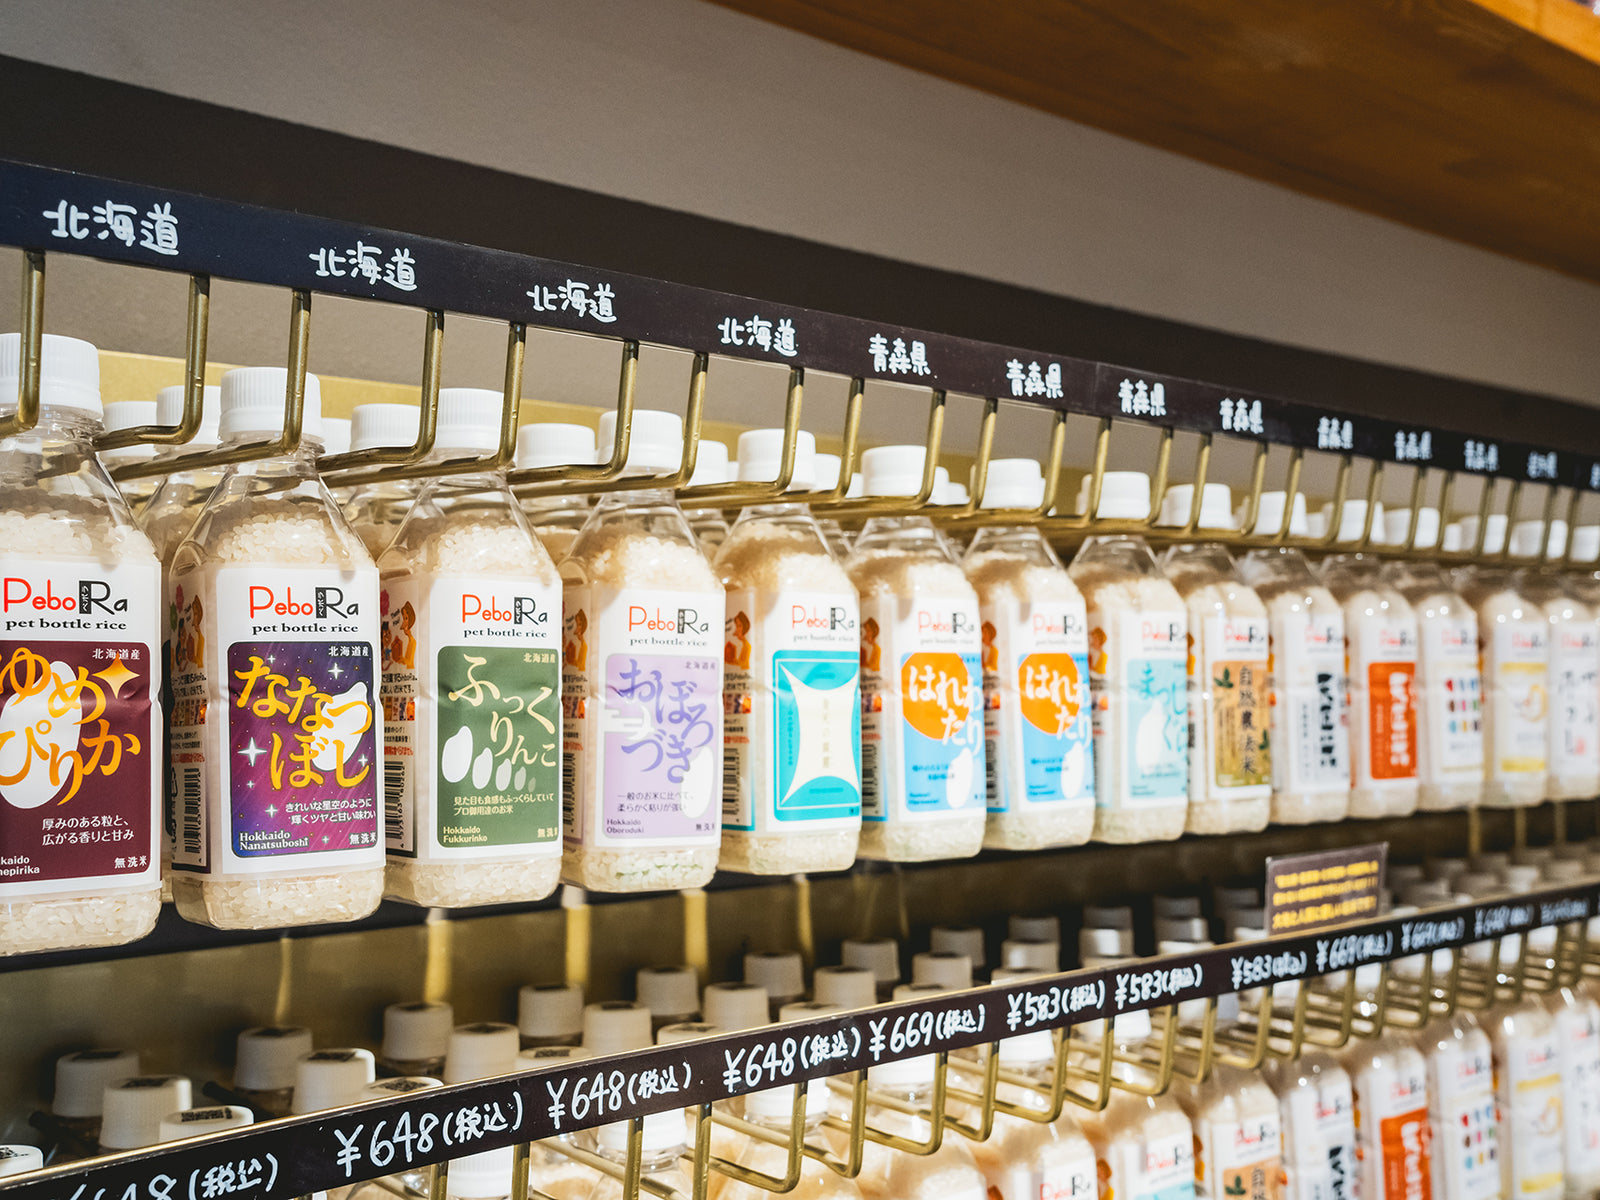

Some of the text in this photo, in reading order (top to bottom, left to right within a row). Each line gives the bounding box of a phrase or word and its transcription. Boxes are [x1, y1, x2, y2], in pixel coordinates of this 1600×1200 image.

[43, 200, 180, 255] 北海道
[309, 241, 417, 291] 北海道
[526, 279, 617, 322] 北海道
[717, 315, 798, 357] 北海道
[868, 332, 932, 376] 青森県
[1005, 358, 1065, 399] 青森県
[1118, 379, 1166, 416] 青森県
[6, 618, 127, 631] pet bottle rice
[253, 622, 359, 635] pet bottle rice
[464, 627, 547, 639] pet bottle rice
[630, 637, 707, 647] pet bottle rice
[92, 648, 140, 660] 北海道産
[328, 645, 369, 657] 北海道産
[0, 647, 107, 725] ゆめ
[234, 656, 373, 735] ななつ
[448, 653, 556, 735] ふっく
[619, 658, 714, 749] おぼろ
[909, 664, 984, 713] はれわ
[1025, 664, 1092, 709] はれわ
[490, 711, 557, 767] りんこ
[941, 707, 983, 758] たり
[1056, 704, 1092, 749] たり
[0, 718, 141, 806] ぴりか
[271, 732, 370, 790] ぼし
[621, 729, 692, 784] づき
[285, 798, 372, 813] きれいな星空のように
[290, 810, 377, 825] 輝くツヤと甘い味わい
[454, 793, 554, 806] 見た目も食感もふっくらしていて
[454, 805, 514, 816] プロ御用達のお米
[42, 815, 129, 831] 厚みのある粒と、
[42, 829, 135, 846] 広がる香りと甘み
[240, 830, 291, 841] Hokkaido
[240, 838, 309, 850] Nanatsuboshi
[349, 831, 377, 845] 無洗米
[443, 826, 480, 835] Hokkaido
[443, 834, 488, 843] Fukkurinko
[0, 855, 30, 865] kaido
[0, 865, 40, 877] epirika
[114, 855, 147, 869] 無洗米
[1006, 978, 1106, 1032] ¥583(税込)
[868, 1003, 986, 1062] ¥669(税込)
[722, 1026, 861, 1094] ¥648(税込)
[544, 1060, 694, 1130] ¥648(税込)
[334, 1091, 523, 1177] ¥648(税込)
[67, 1152, 279, 1200] 8(税込)
